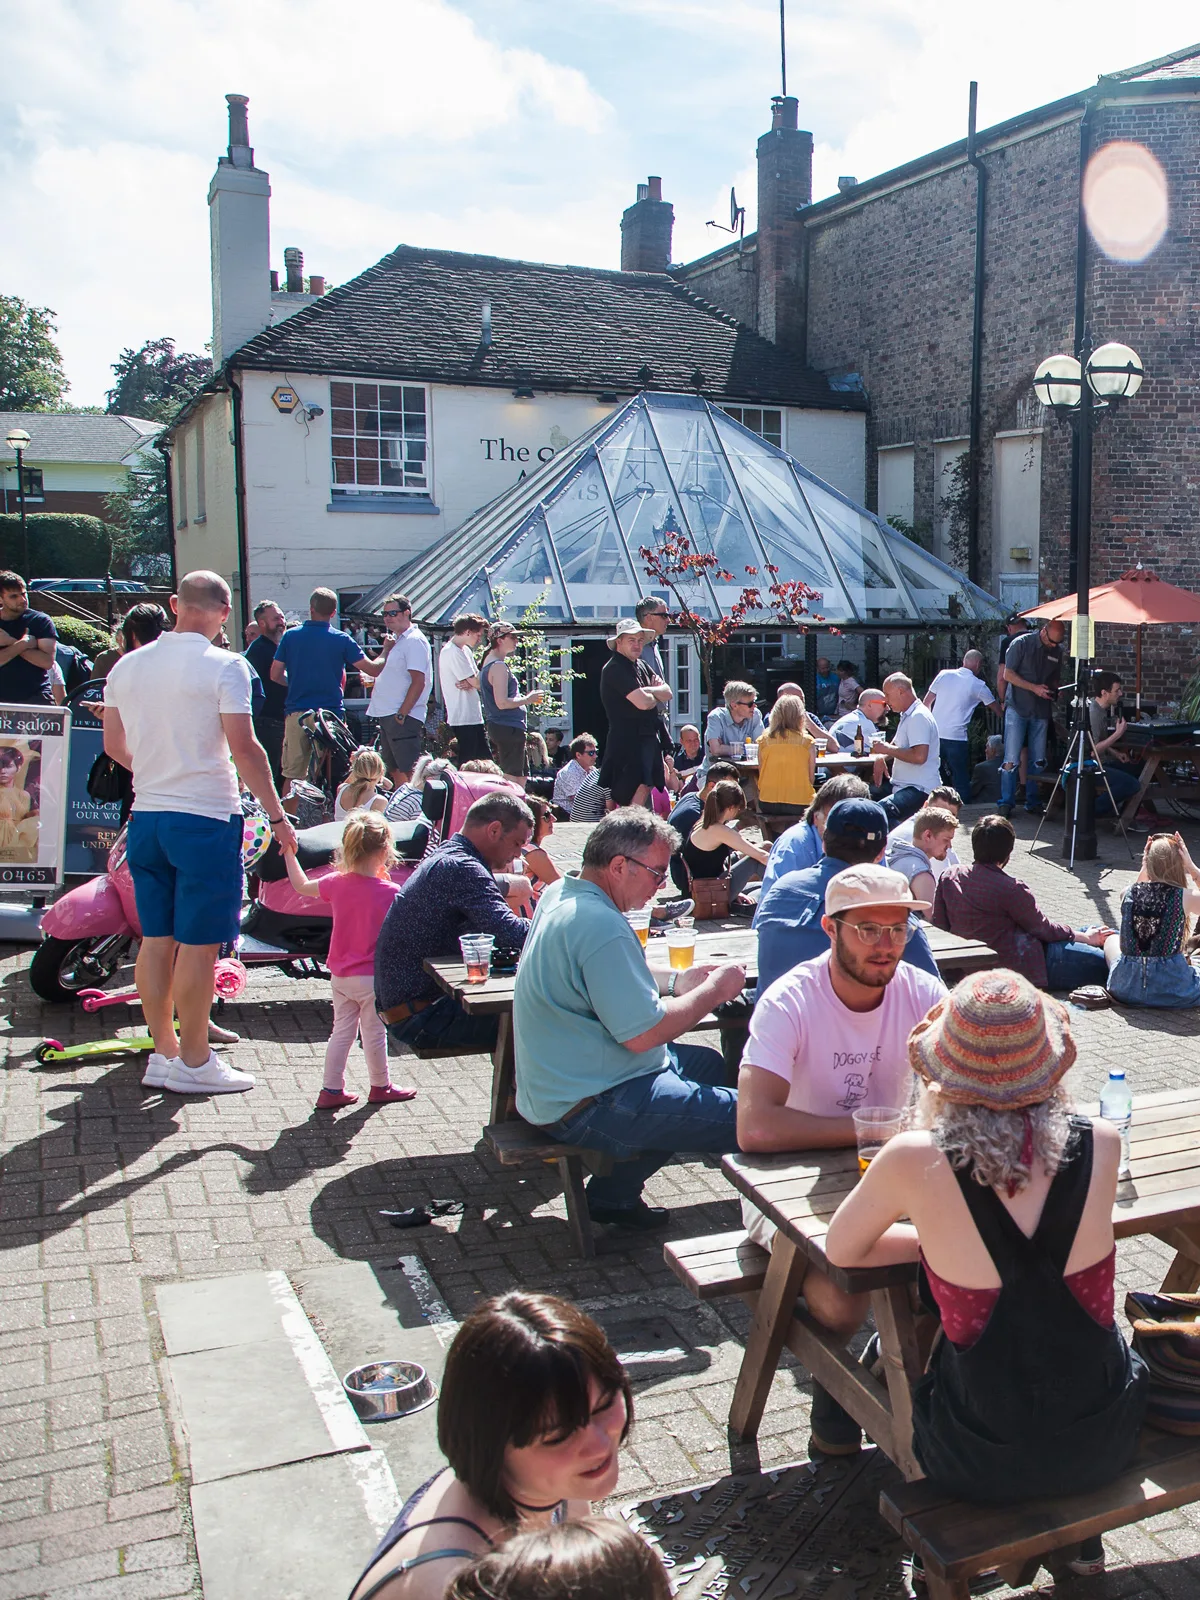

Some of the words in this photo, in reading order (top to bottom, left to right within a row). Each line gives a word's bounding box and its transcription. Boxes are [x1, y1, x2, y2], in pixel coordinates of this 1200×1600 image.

[480, 438, 529, 462] The
[74, 719, 102, 727] JEWEL
[76, 810, 100, 820] OUR
[103, 811, 120, 821] WO
[97, 831, 117, 841] REP
[82, 840, 113, 850] UNDE
[834, 1052, 868, 1070] DOGGY
[683, 1481, 748, 1539] CHIEFTAIN
